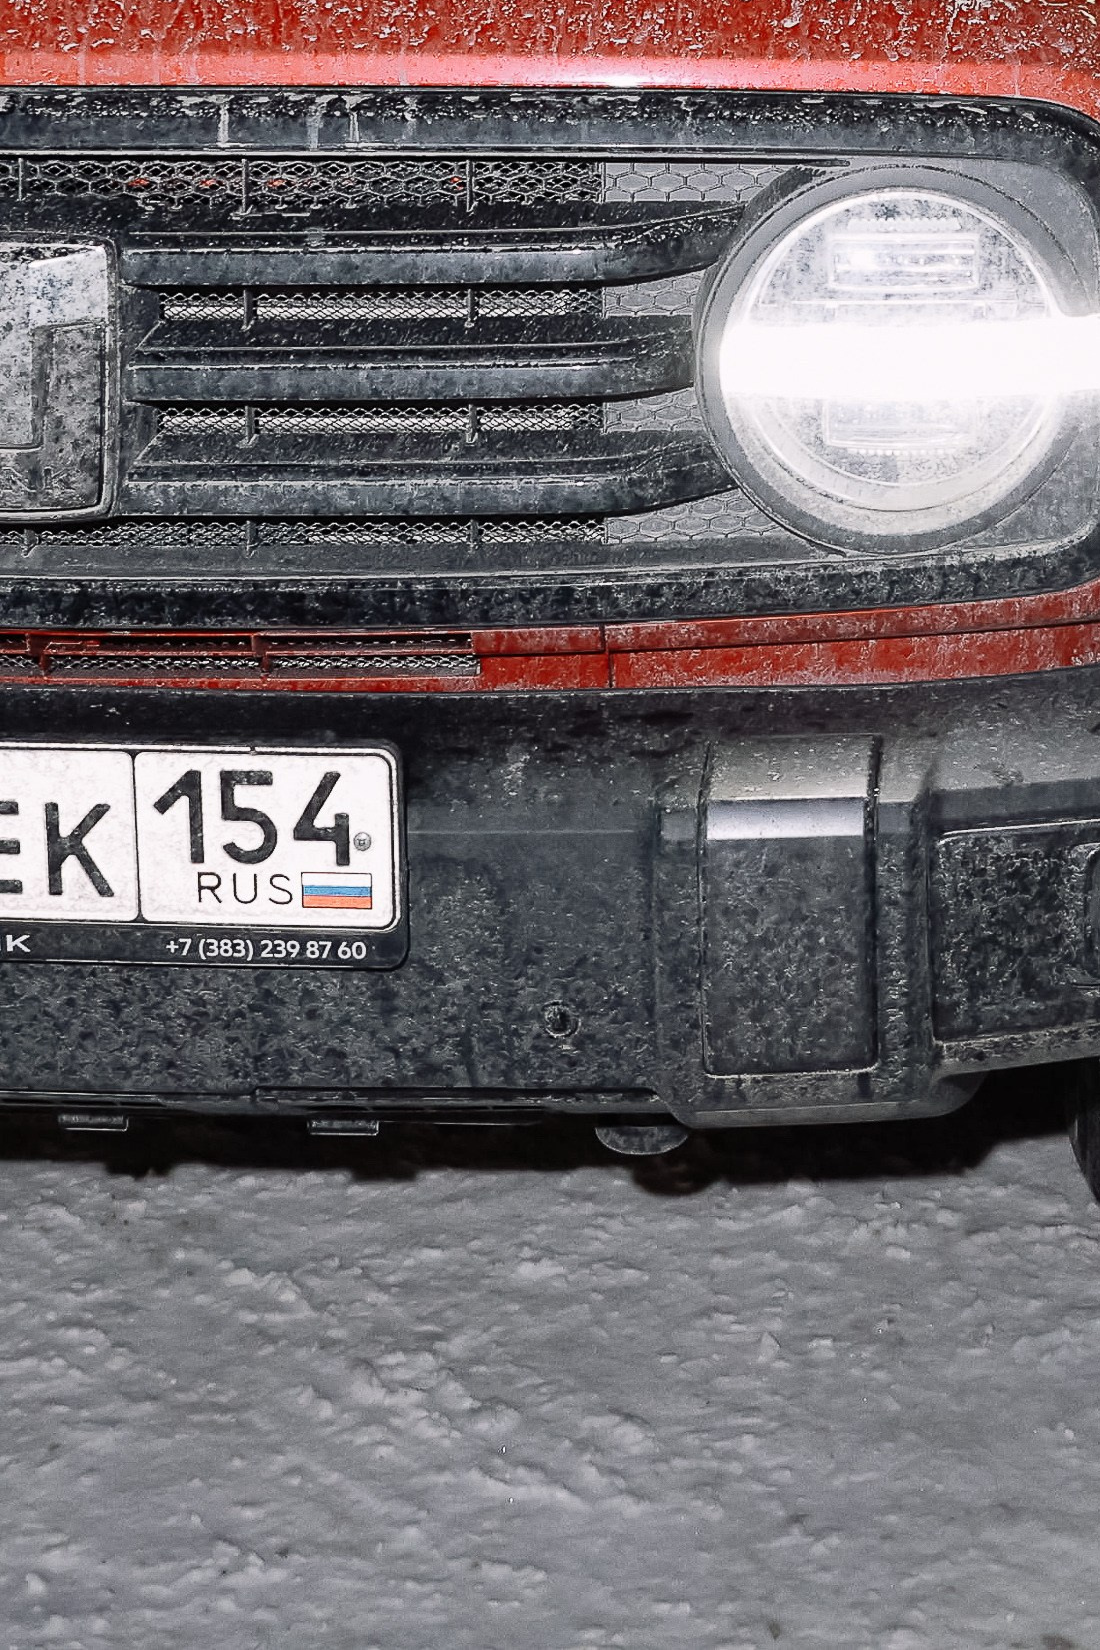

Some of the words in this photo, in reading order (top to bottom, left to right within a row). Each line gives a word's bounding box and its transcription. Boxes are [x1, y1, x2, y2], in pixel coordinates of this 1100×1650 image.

[153, 769, 351, 866] 154
[198, 871, 293, 905] RUS
[0, 934, 31, 952] K
[166, 938, 192, 956] +7
[198, 938, 254, 961] (383)
[260, 939, 300, 958] 239
[306, 940, 332, 959] 87
[337, 941, 367, 960] 60
